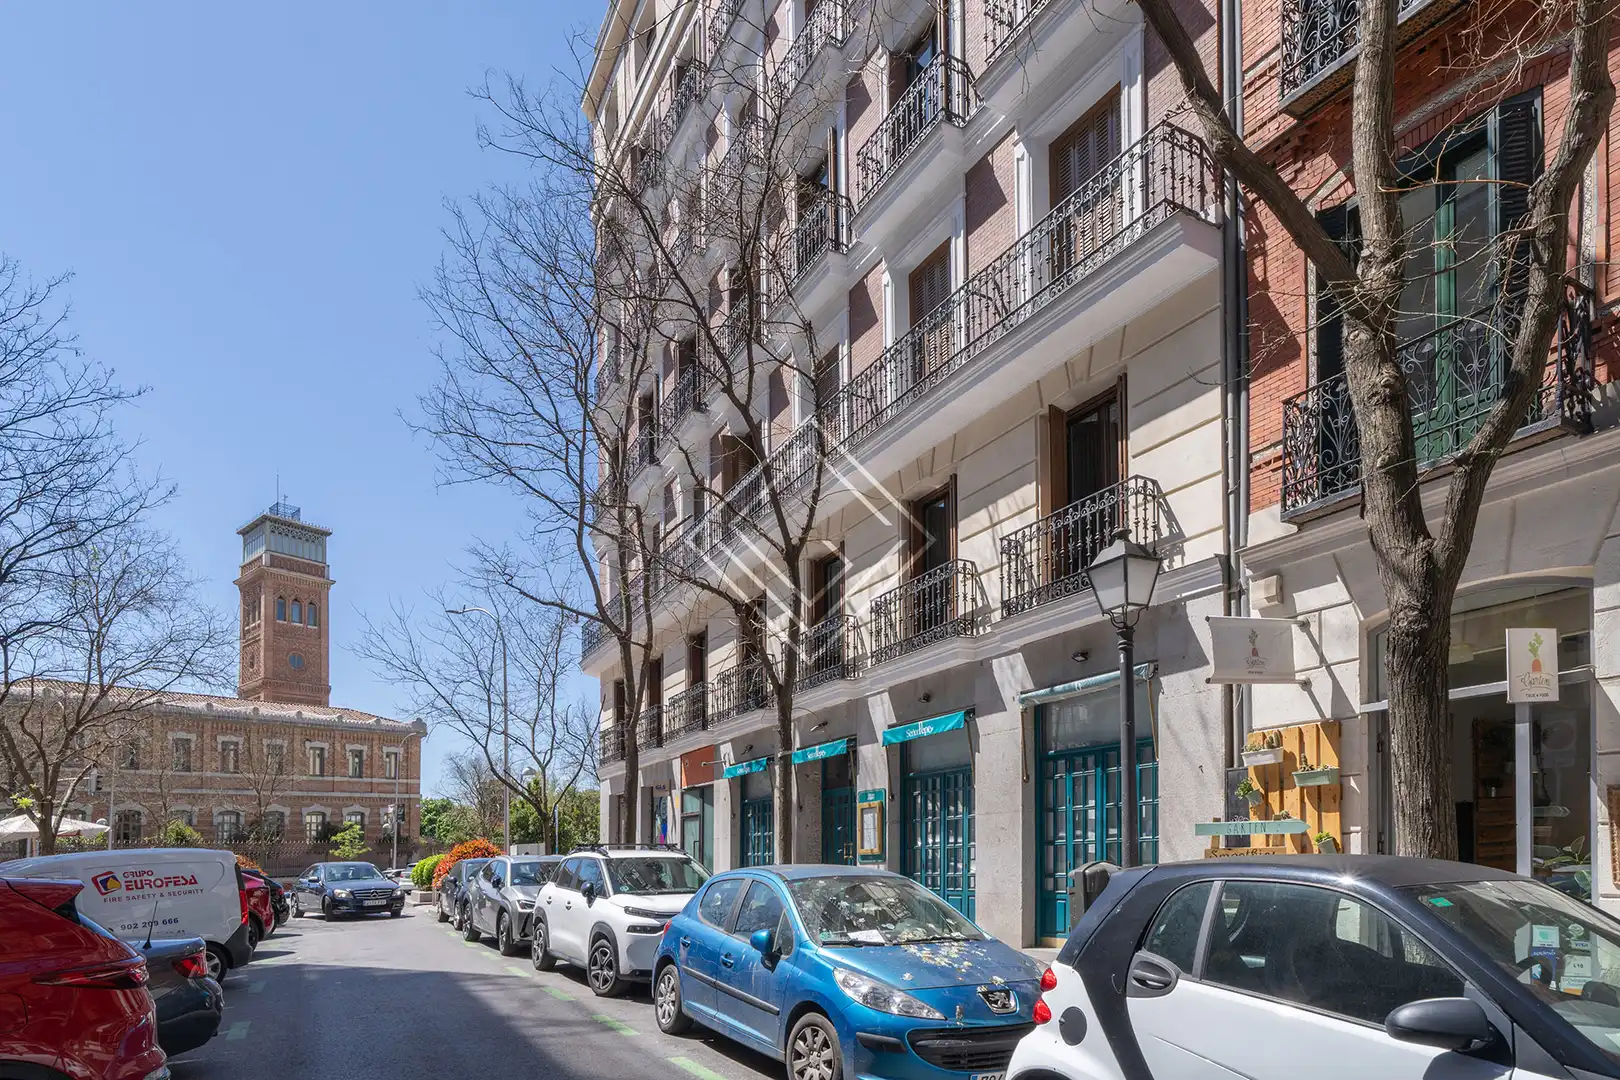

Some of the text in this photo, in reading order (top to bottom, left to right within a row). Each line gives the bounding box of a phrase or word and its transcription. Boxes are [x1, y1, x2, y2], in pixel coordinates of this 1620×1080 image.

[122, 870, 154, 879] GRUPO
[124, 875, 199, 891] EUROFESA
[125, 892, 157, 901] SAFETY
[167, 888, 205, 897] SECURITY
[120, 917, 179, 931] 902 209 666
